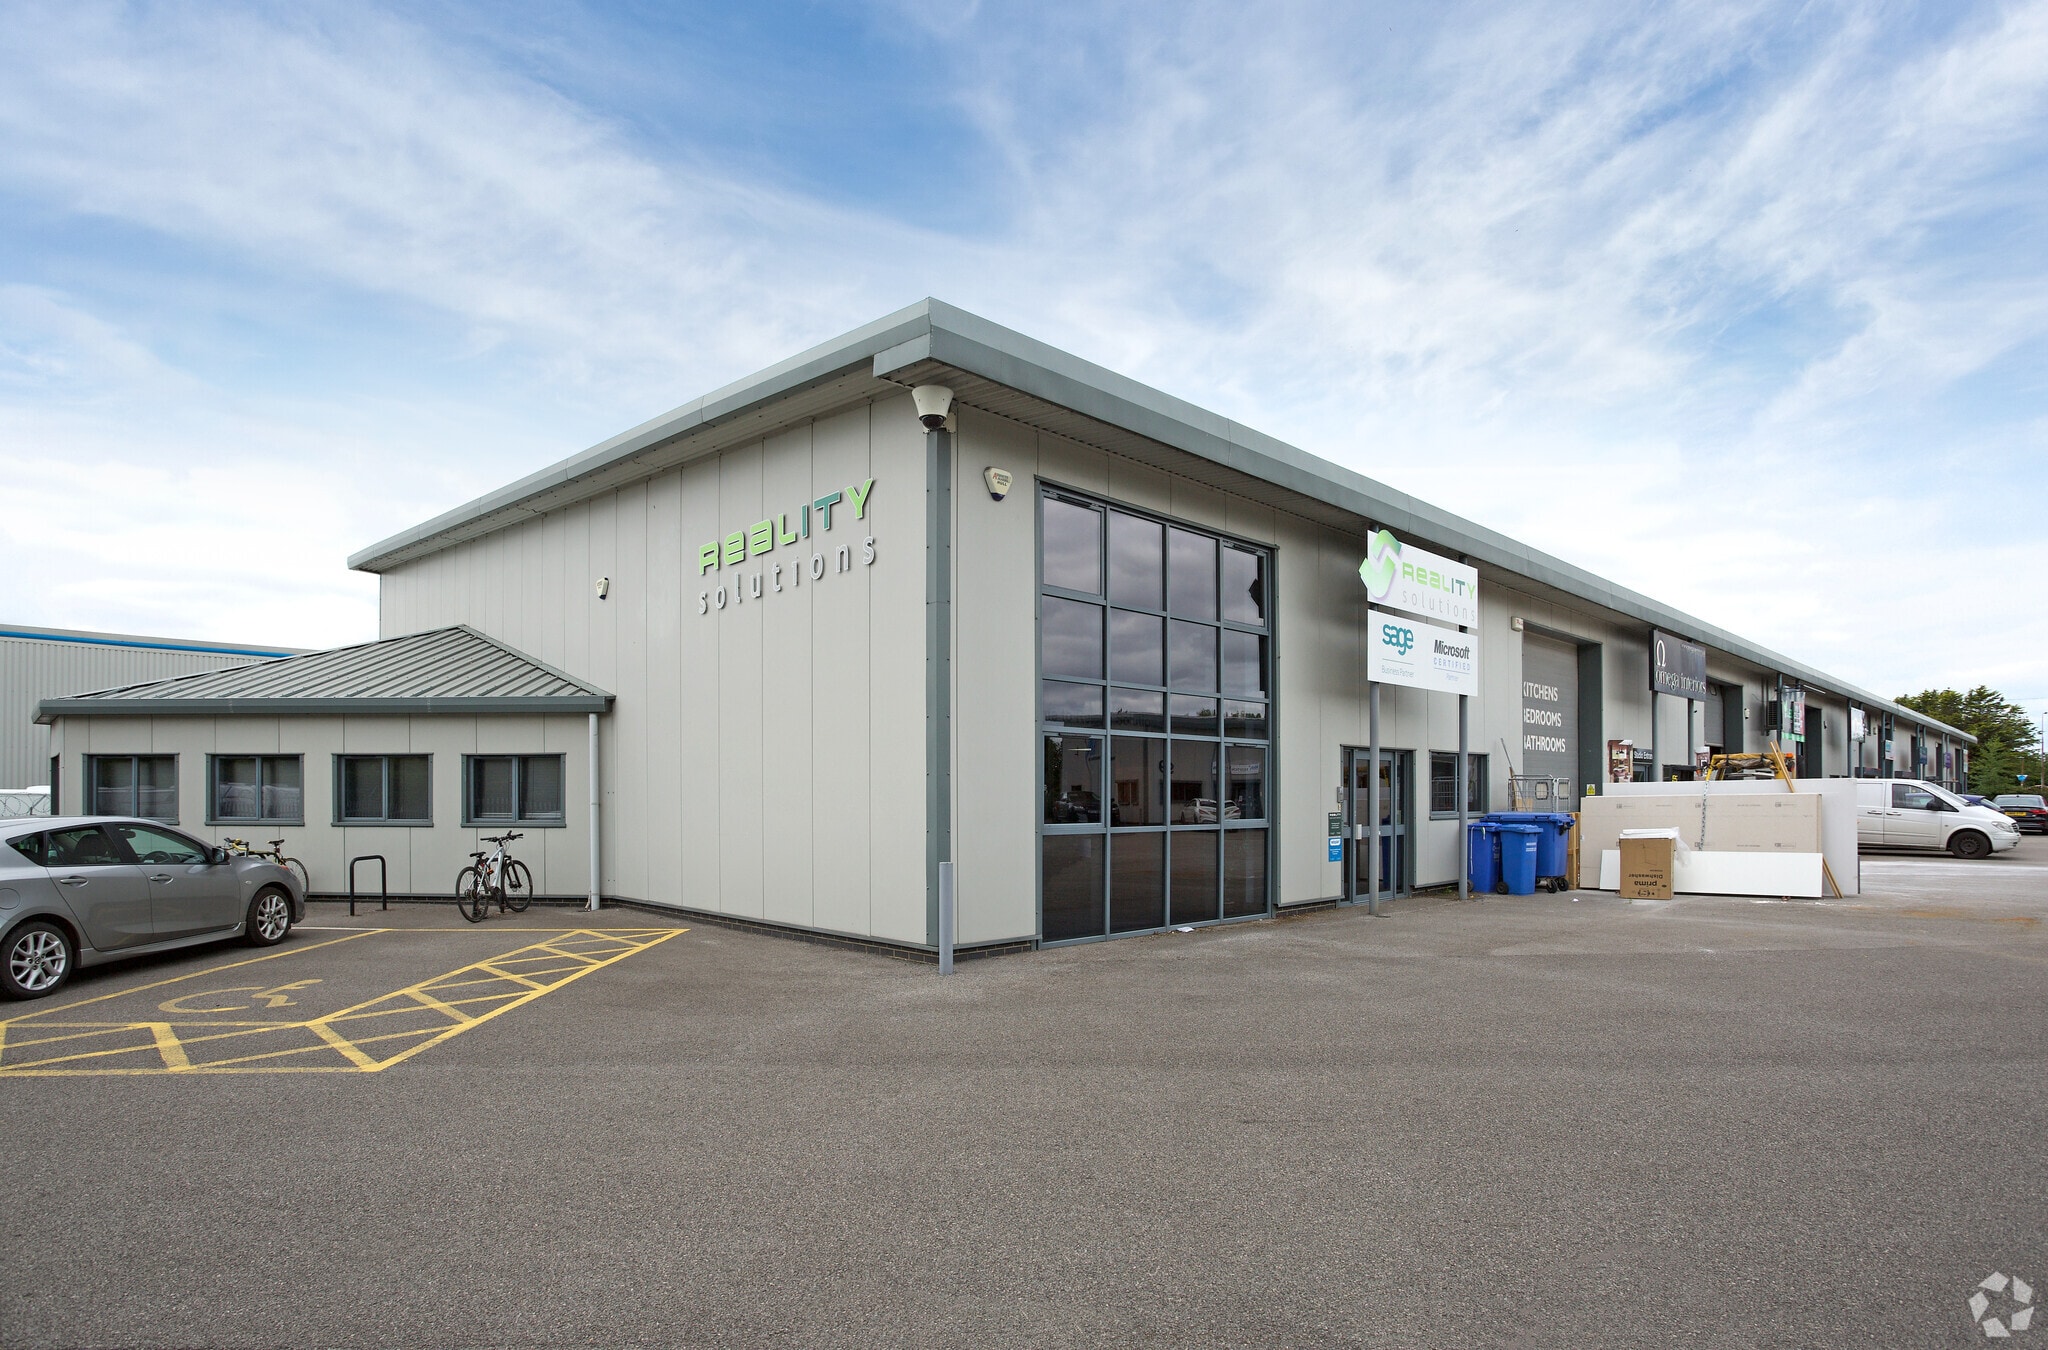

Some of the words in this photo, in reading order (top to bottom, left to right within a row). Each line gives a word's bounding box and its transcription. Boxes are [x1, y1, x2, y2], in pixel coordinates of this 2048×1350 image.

[699, 536, 875, 614] solutions
[1403, 590, 1475, 622] solutions
[1382, 624, 1414, 656] sage
[1433, 639, 1470, 660] Microsoft
[1433, 657, 1470, 671] CERTIFIED
[1655, 669, 1679, 691] omega
[1680, 673, 1706, 695] interiors
